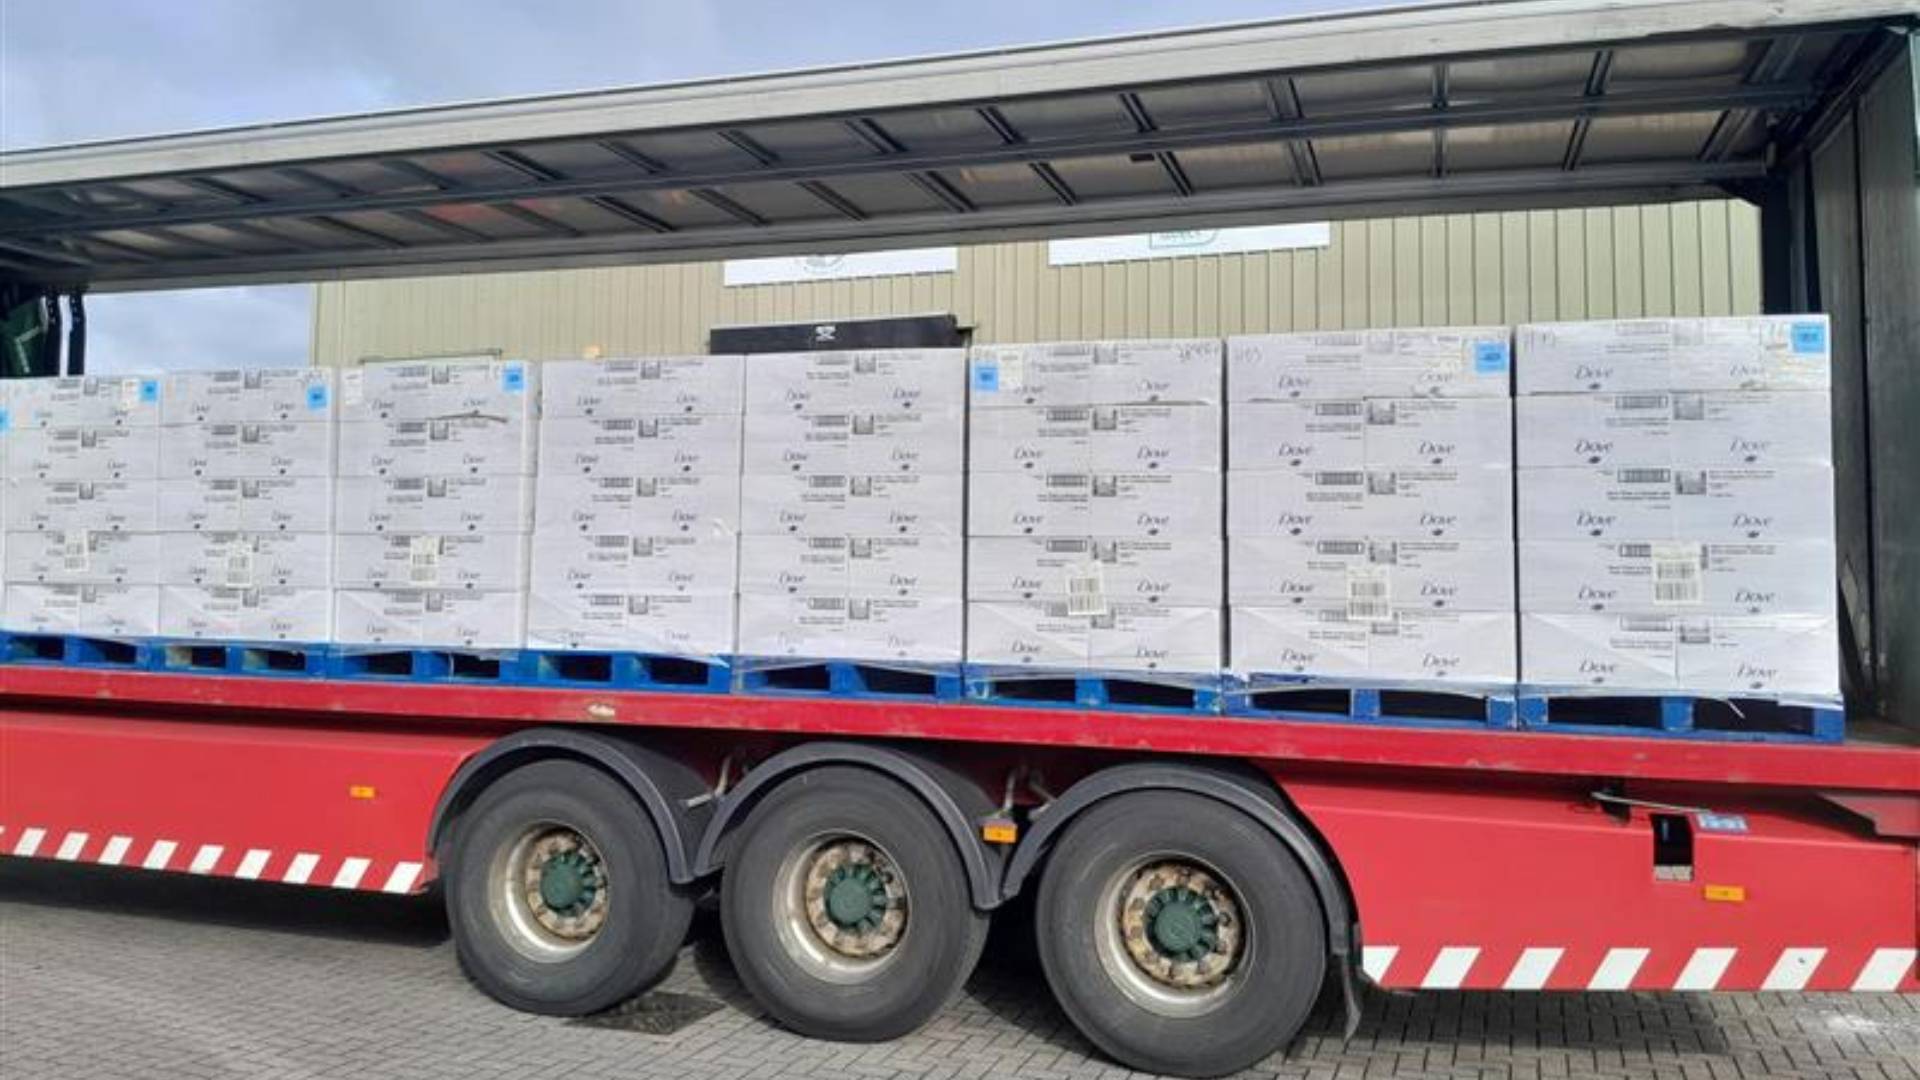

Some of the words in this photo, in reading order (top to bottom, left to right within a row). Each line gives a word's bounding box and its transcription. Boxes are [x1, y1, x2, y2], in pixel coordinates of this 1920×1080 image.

[1574, 366, 1613, 379] Dove
[1278, 375, 1312, 388] Dove
[786, 389, 811, 400] Dove
[892, 387, 921, 399] Dove
[1278, 444, 1314, 456] Dove
[1420, 442, 1456, 454] Dove
[1574, 439, 1613, 452] Dove
[1730, 439, 1771, 452] Dove
[783, 451, 809, 461] Dove
[891, 450, 919, 461] Dove
[1013, 448, 1043, 459] Dove
[1137, 447, 1170, 459] Dove
[779, 511, 807, 522] Dove
[889, 512, 918, 523] Dove
[1013, 514, 1043, 524] Dove
[1137, 514, 1170, 525] Dove
[1278, 513, 1313, 526] Dove
[1420, 514, 1458, 526] Dove
[1576, 514, 1616, 527] Dove
[1732, 514, 1773, 528] Dove
[779, 573, 806, 583] Dove
[889, 575, 918, 585] Dove
[1012, 577, 1043, 589] Dove
[1137, 581, 1170, 593] Dove
[1280, 581, 1314, 594] Dove
[1420, 585, 1458, 596] Dove
[1578, 587, 1616, 600] Dove
[1735, 591, 1774, 604] Dove
[1012, 641, 1042, 652] Dove
[1136, 648, 1169, 659] Dove
[1281, 650, 1318, 662] Dove
[1422, 654, 1460, 667] Dove
[1579, 660, 1618, 673] Dove
[1737, 664, 1778, 678] Dove
